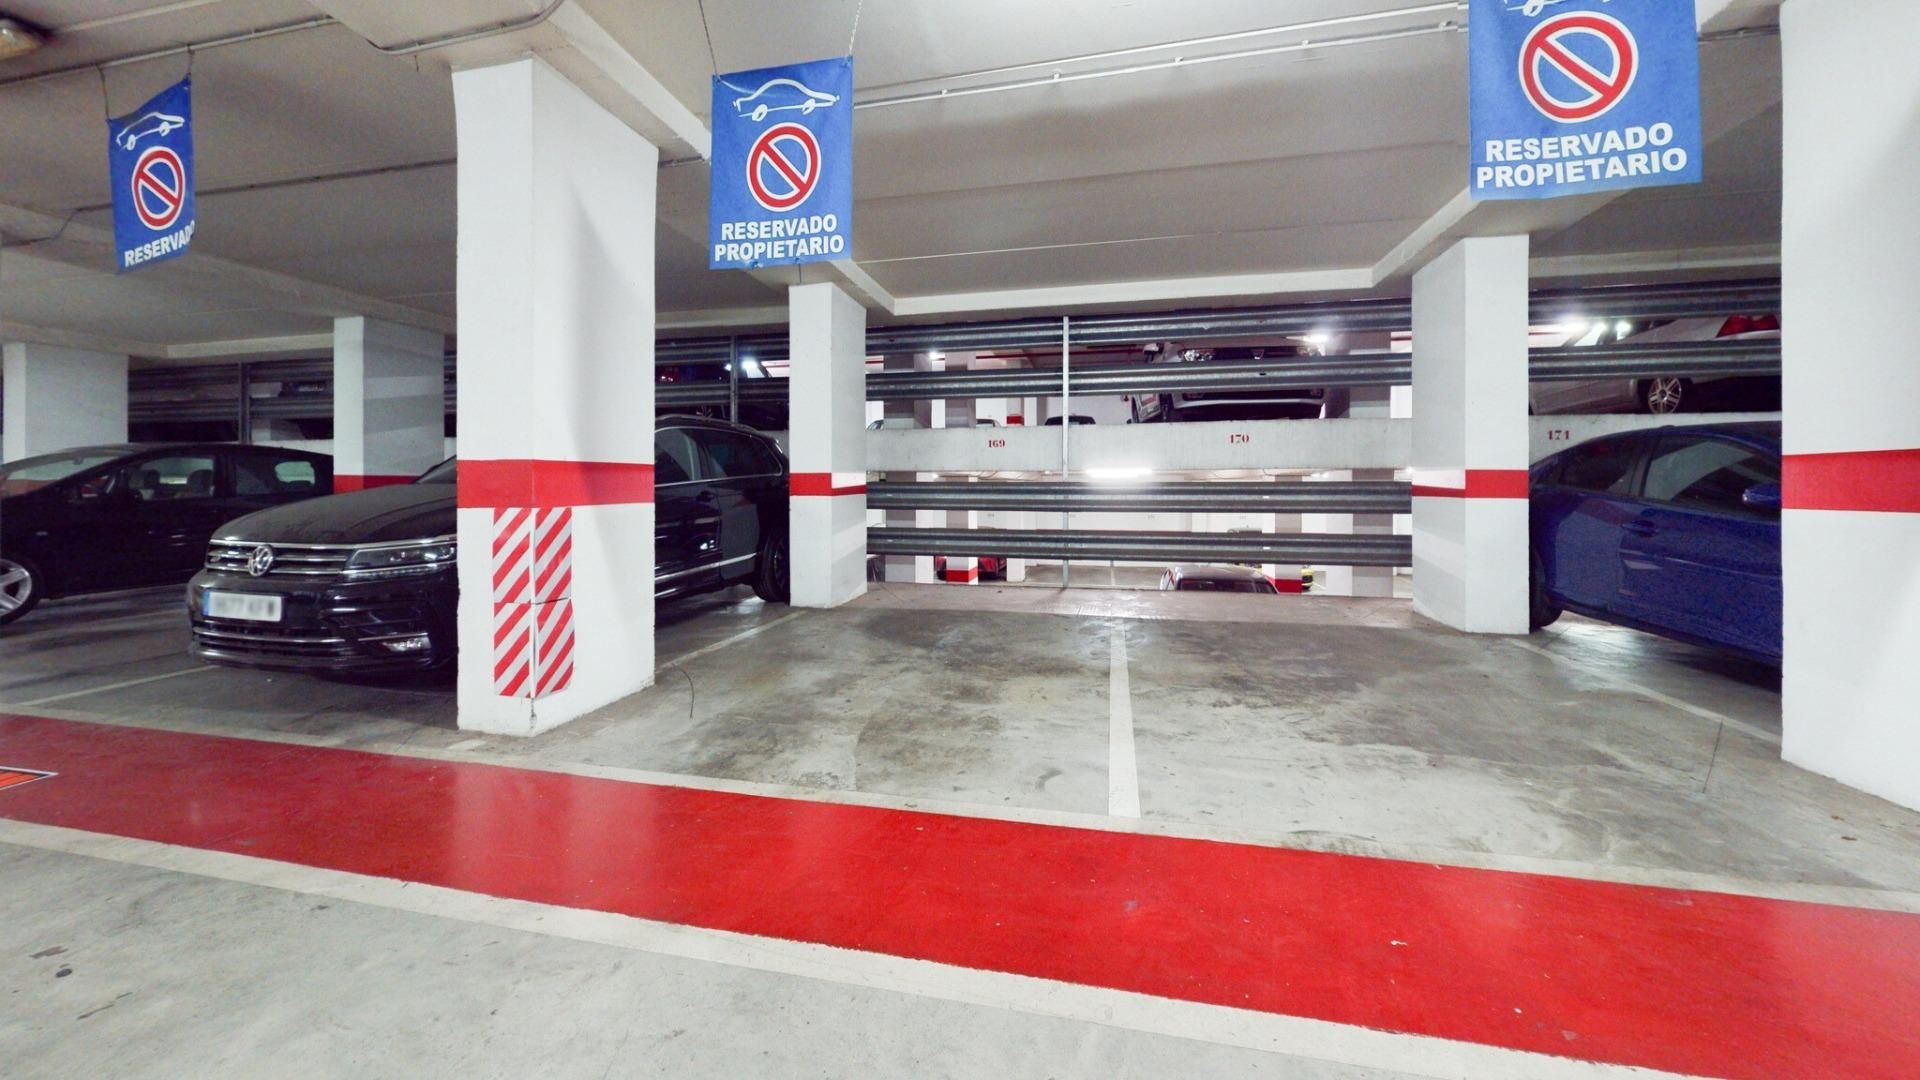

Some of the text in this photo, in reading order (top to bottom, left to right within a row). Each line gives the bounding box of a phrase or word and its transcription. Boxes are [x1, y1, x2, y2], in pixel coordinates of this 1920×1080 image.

[1485, 122, 1674, 162] RESERVADO
[1475, 147, 1688, 189] PROPIETARIO
[721, 213, 837, 241] RESERVADO
[714, 234, 845, 262] PROPIETARIO
[988, 439, 1006, 448] 169
[1229, 433, 1250, 444] 170
[1547, 429, 1570, 441] 171
